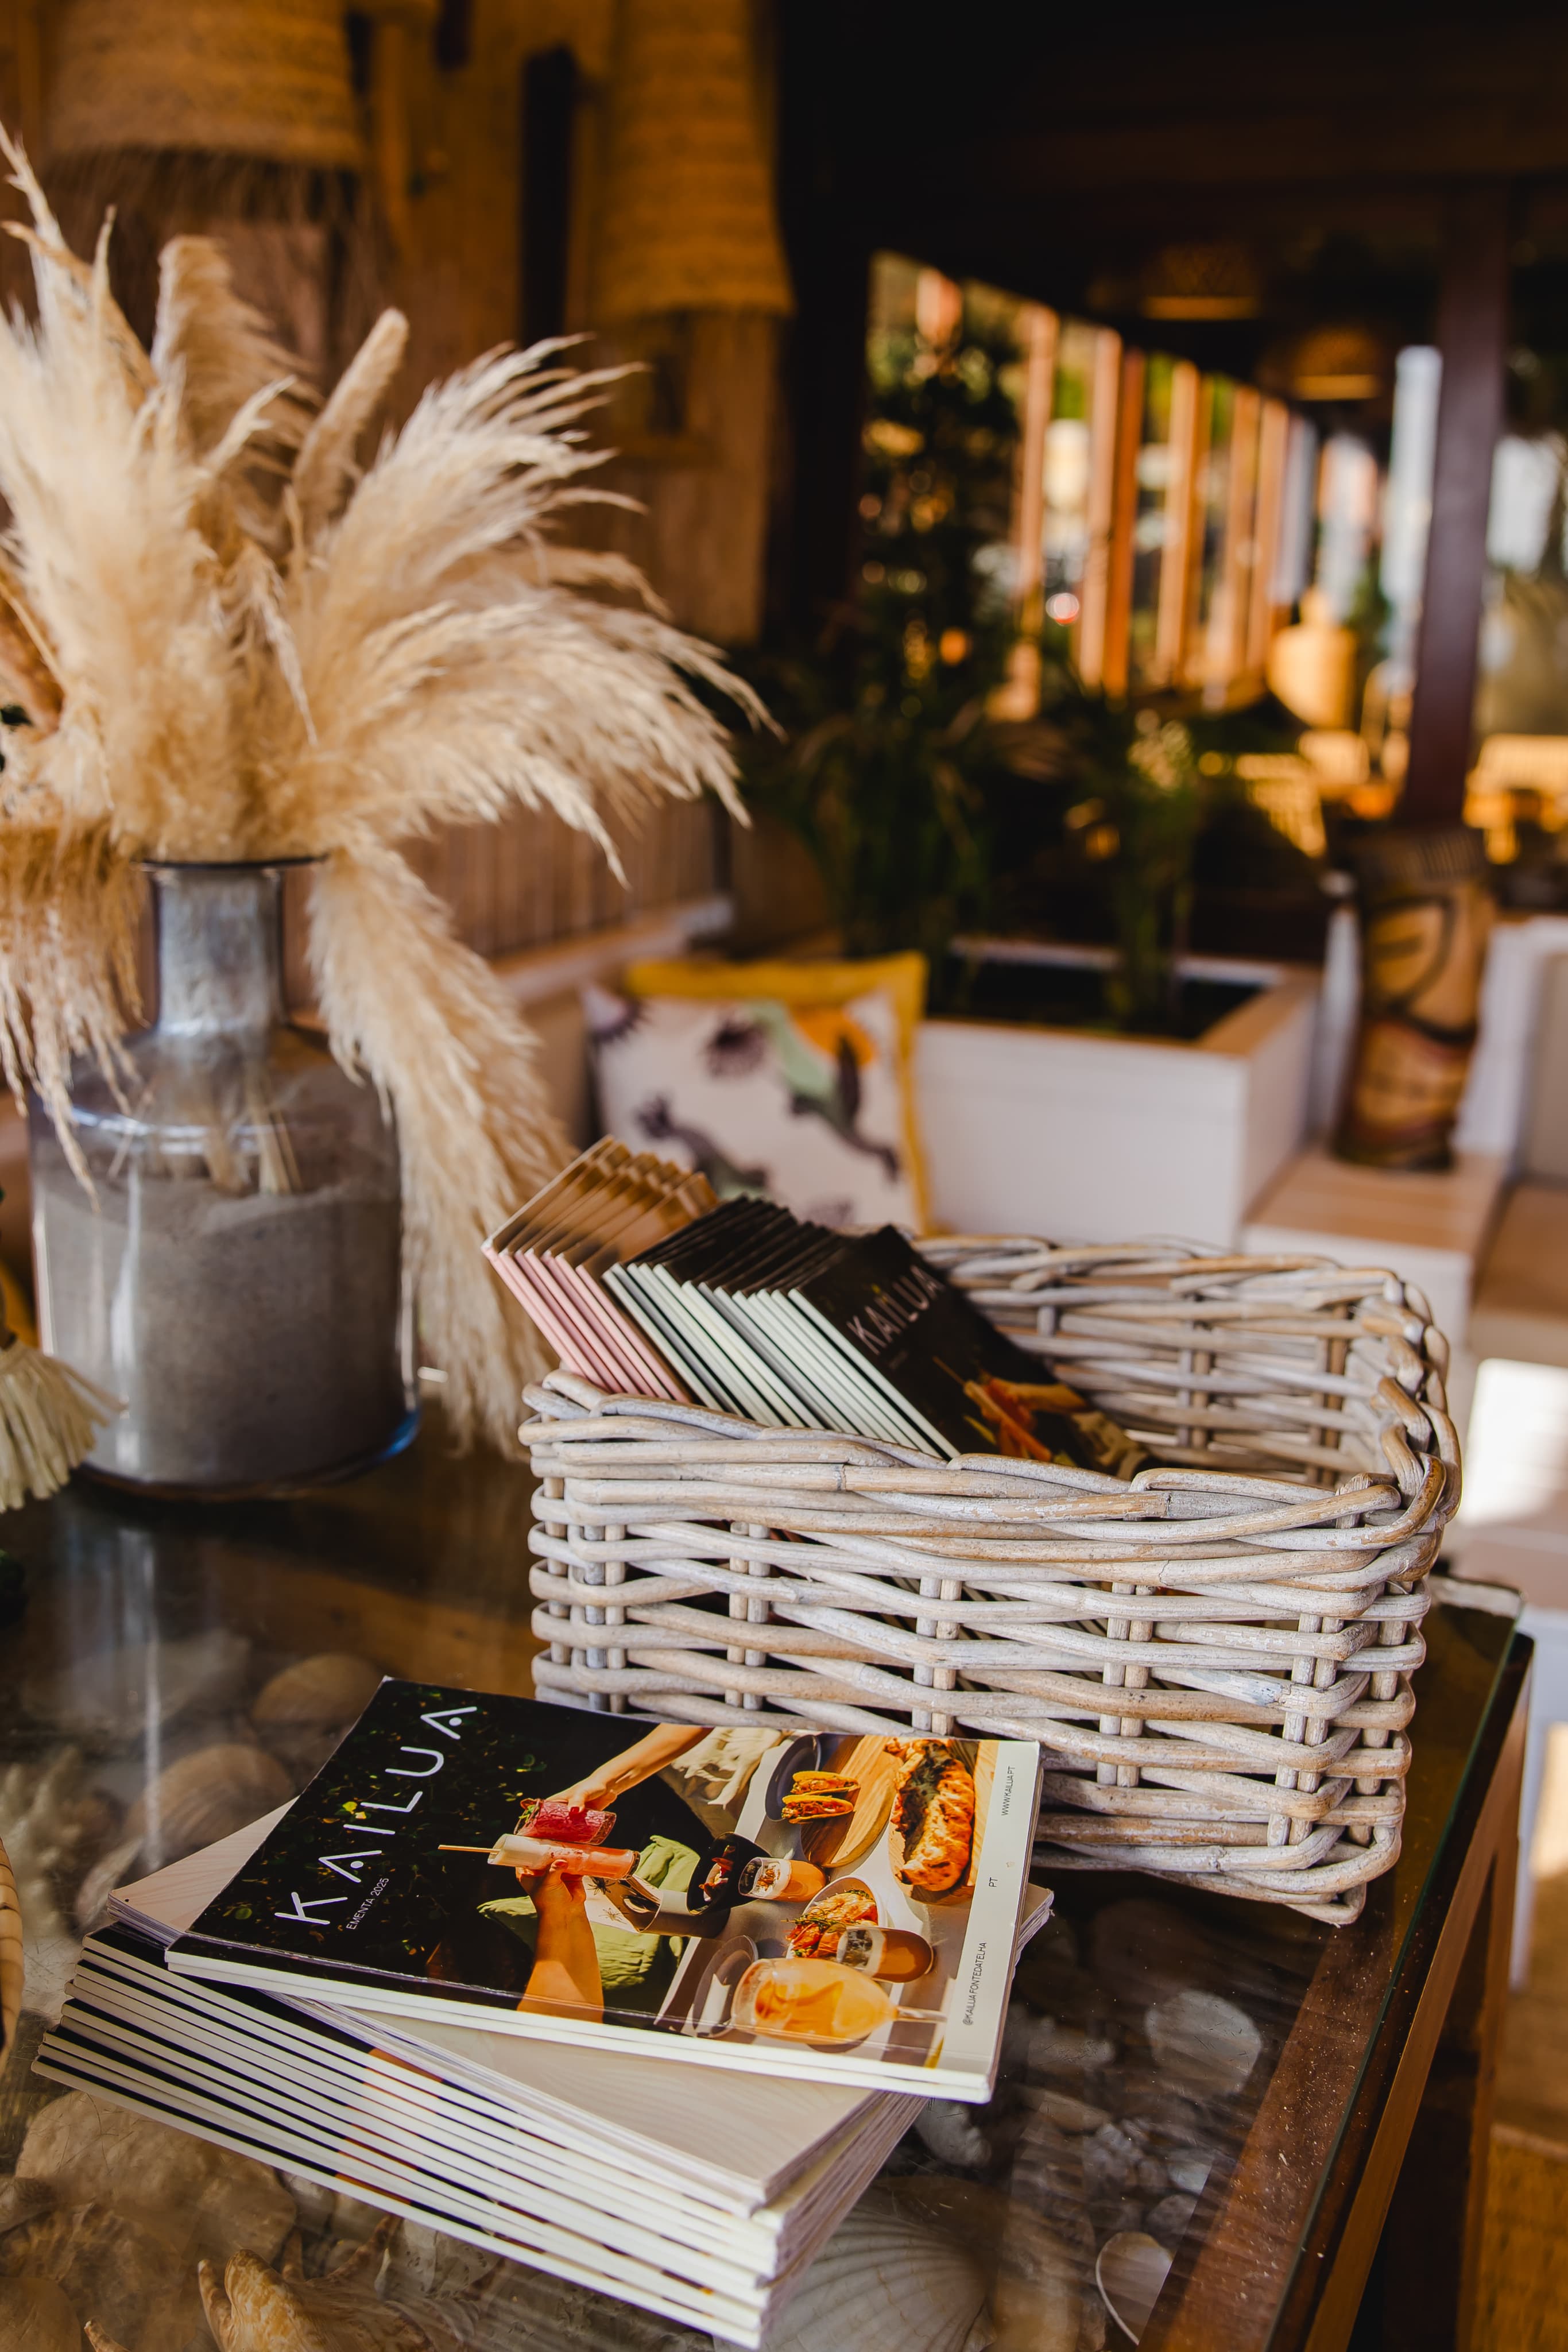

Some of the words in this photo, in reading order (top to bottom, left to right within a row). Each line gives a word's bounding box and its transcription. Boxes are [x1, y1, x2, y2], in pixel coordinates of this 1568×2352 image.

[846, 1265, 946, 1355] KAILUA
[274, 1705, 478, 1925] KAILUA
[346, 1898, 376, 1930] EMENTA
[370, 1877, 389, 1897] 2025
[989, 1877, 998, 1888] PT
